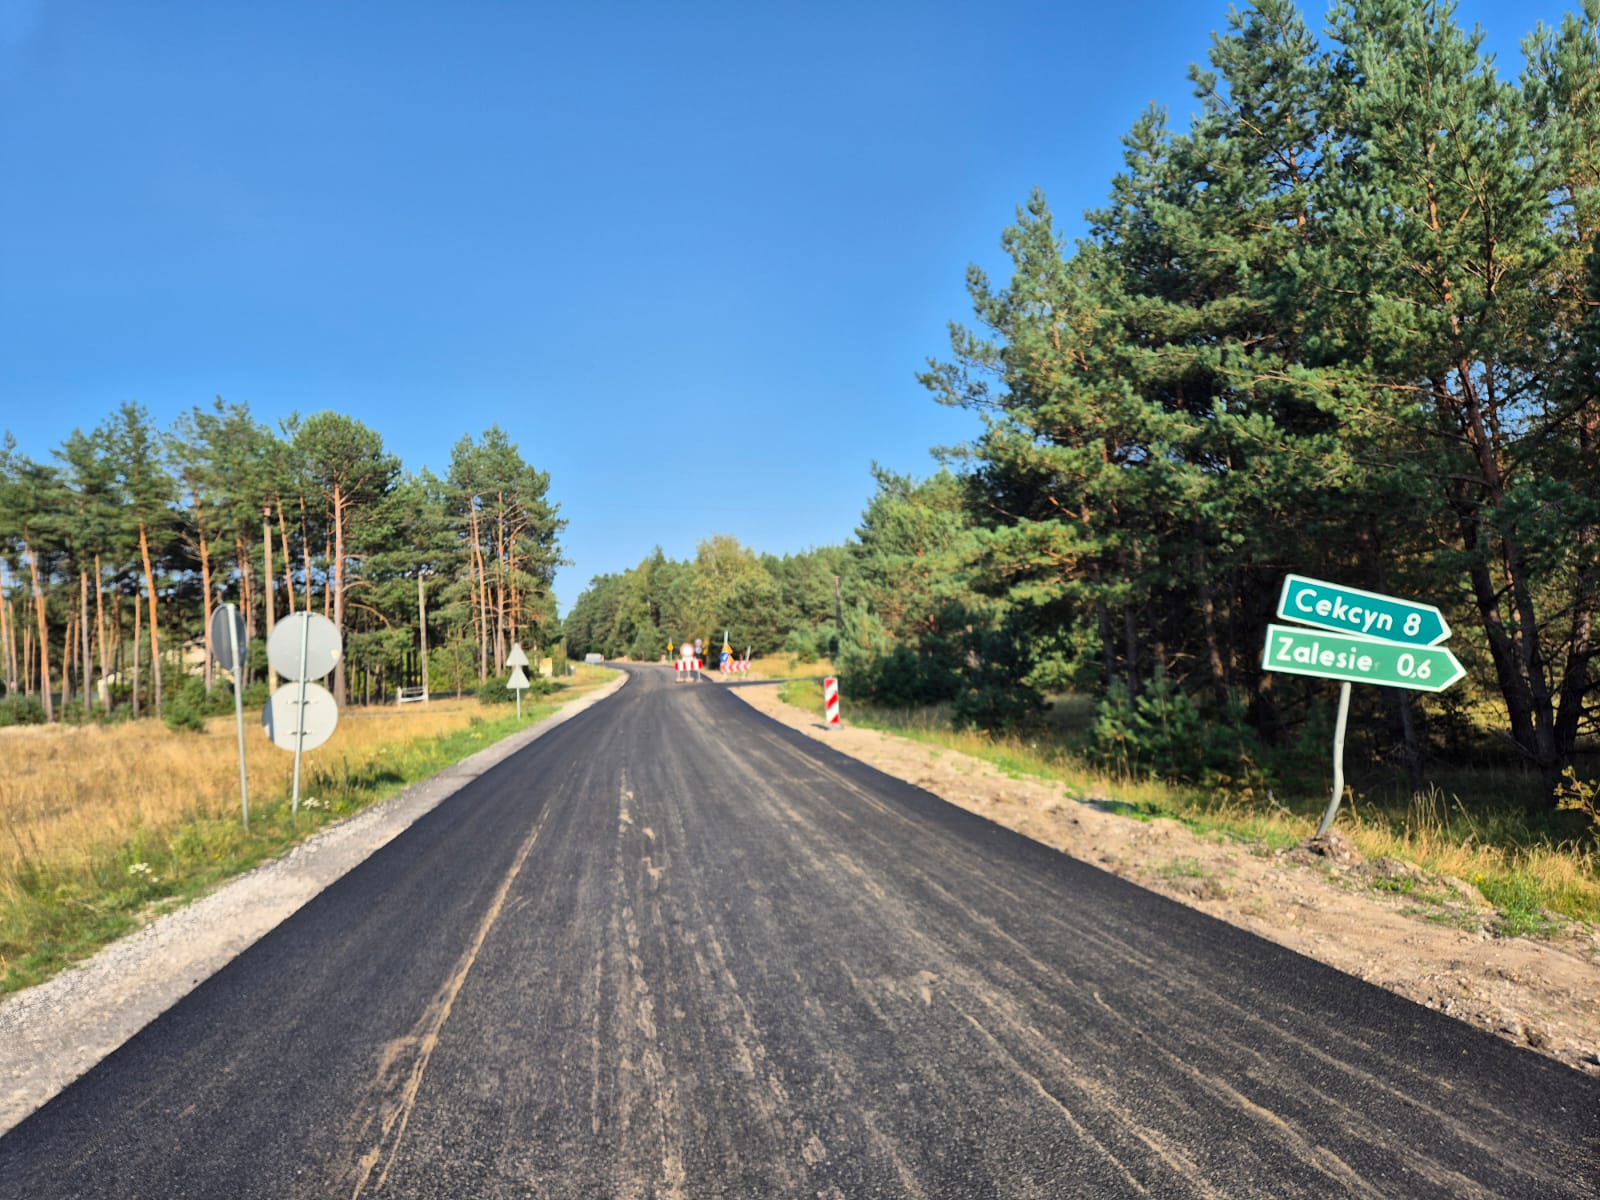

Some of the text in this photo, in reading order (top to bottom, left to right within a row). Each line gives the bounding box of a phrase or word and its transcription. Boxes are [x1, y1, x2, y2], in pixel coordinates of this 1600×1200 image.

[1295, 588, 1422, 637] Cekcyn 8
[1276, 637, 1431, 680] Zalesie 0,6
